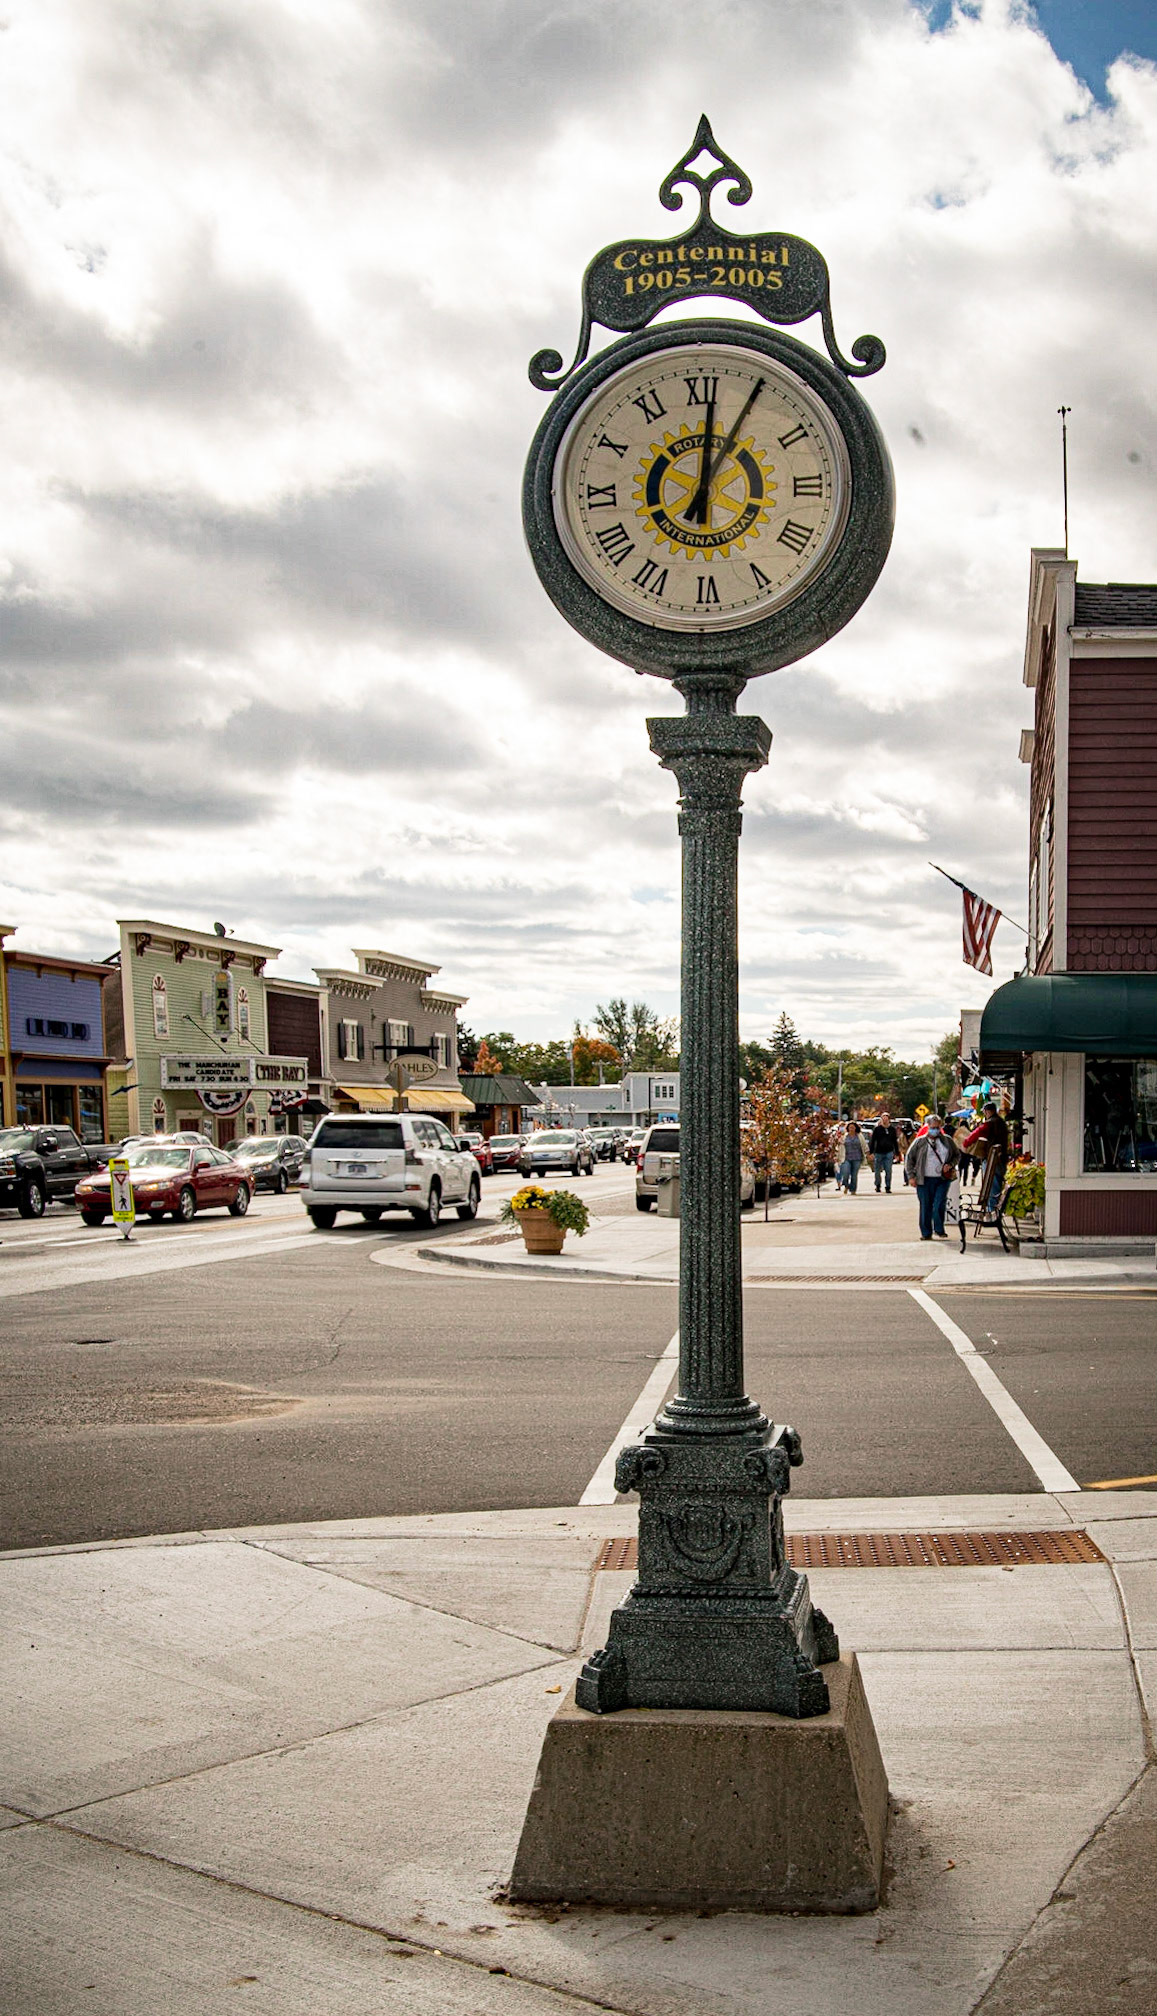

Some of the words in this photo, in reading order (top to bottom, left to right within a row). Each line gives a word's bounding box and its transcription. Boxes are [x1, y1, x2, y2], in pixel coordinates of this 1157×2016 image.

[613, 243, 790, 271] Centennial
[623, 267, 783, 296] 1905-2005
[683, 376, 720, 406] XII
[632, 389, 667, 424] XI
[598, 434, 629, 458] X
[777, 423, 809, 449] II
[587, 483, 617, 510] IX
[793, 473, 823, 498] III
[659, 511, 755, 546] INTERNATIONAL
[595, 522, 635, 567] VIII
[631, 558, 669, 596] VII
[696, 575, 720, 604] VI
[749, 563, 772, 589] V
[217, 988, 229, 1025] BAY
[261, 1064, 281, 1081] THE
[281, 1066, 300, 1082] BAY
